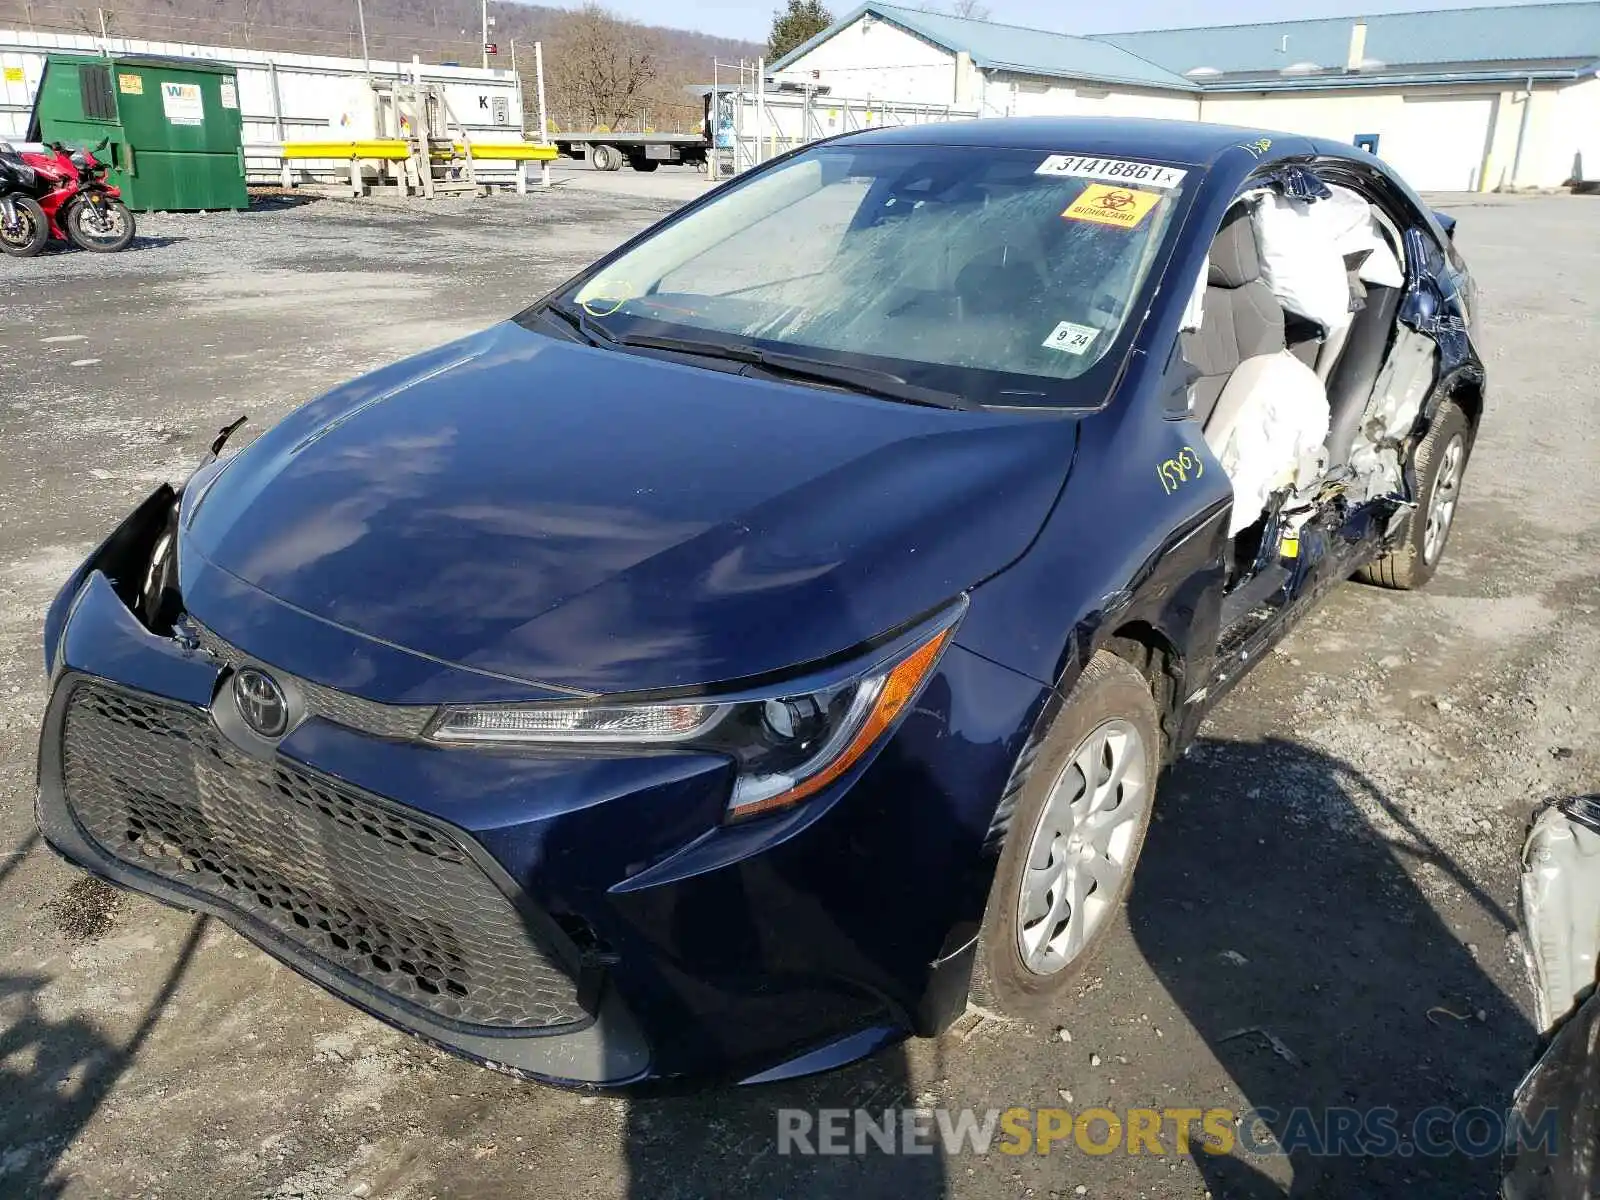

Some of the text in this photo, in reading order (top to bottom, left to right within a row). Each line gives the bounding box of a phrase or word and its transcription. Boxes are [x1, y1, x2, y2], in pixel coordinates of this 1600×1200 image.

[166, 85, 197, 98] WM
[478, 95, 488, 109] K
[498, 111, 505, 122] 5
[1056, 157, 1164, 182] 31418861
[1073, 206, 1136, 222] BIOHAZARD
[1056, 330, 1089, 347] 9 24
